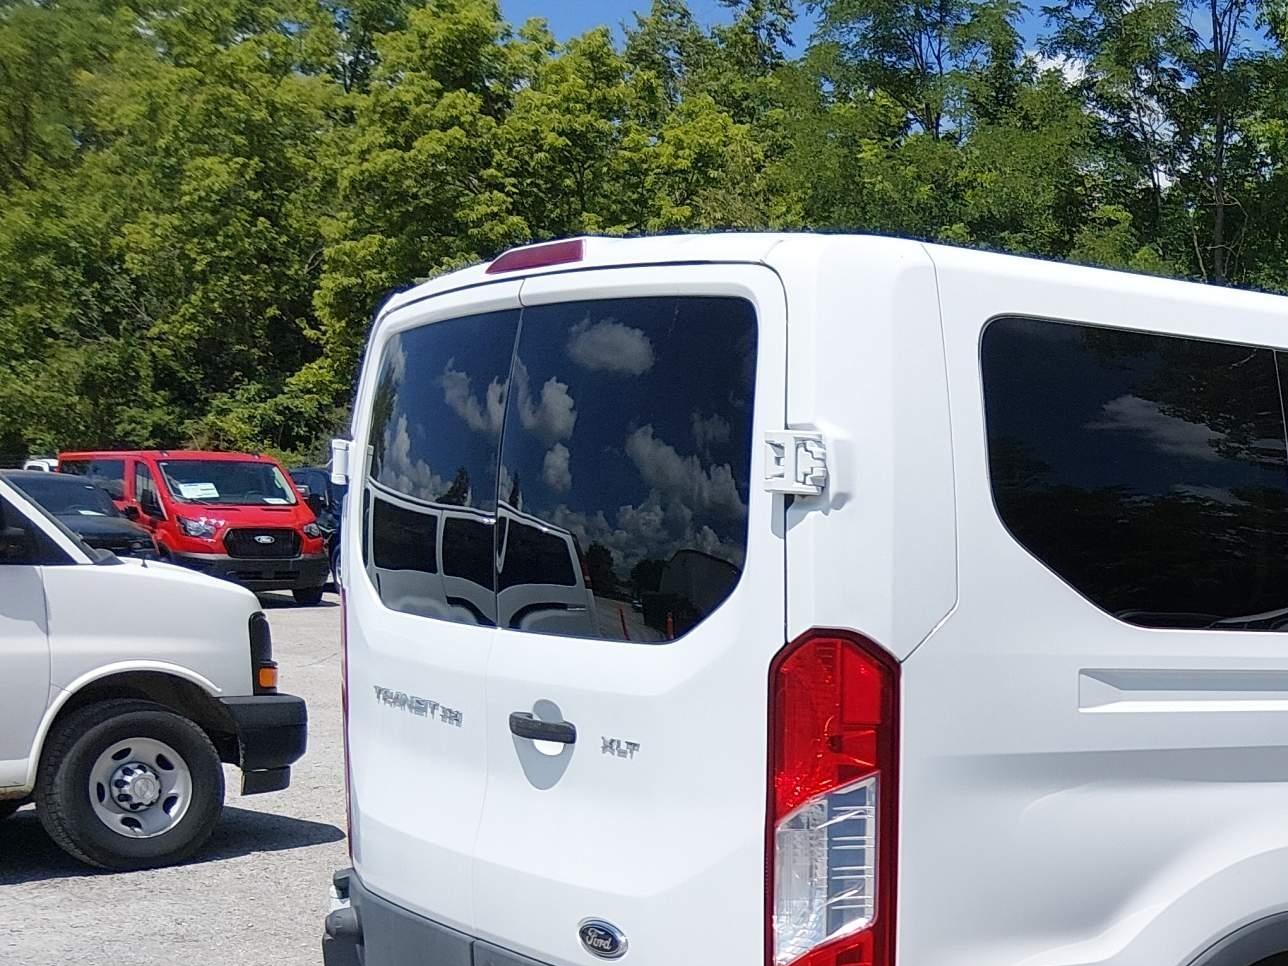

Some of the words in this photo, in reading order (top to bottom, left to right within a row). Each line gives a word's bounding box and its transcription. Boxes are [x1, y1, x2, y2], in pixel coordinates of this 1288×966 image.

[373, 685, 440, 720] TRANSIT
[601, 736, 641, 761] XLT
[585, 927, 612, 950] Ford
